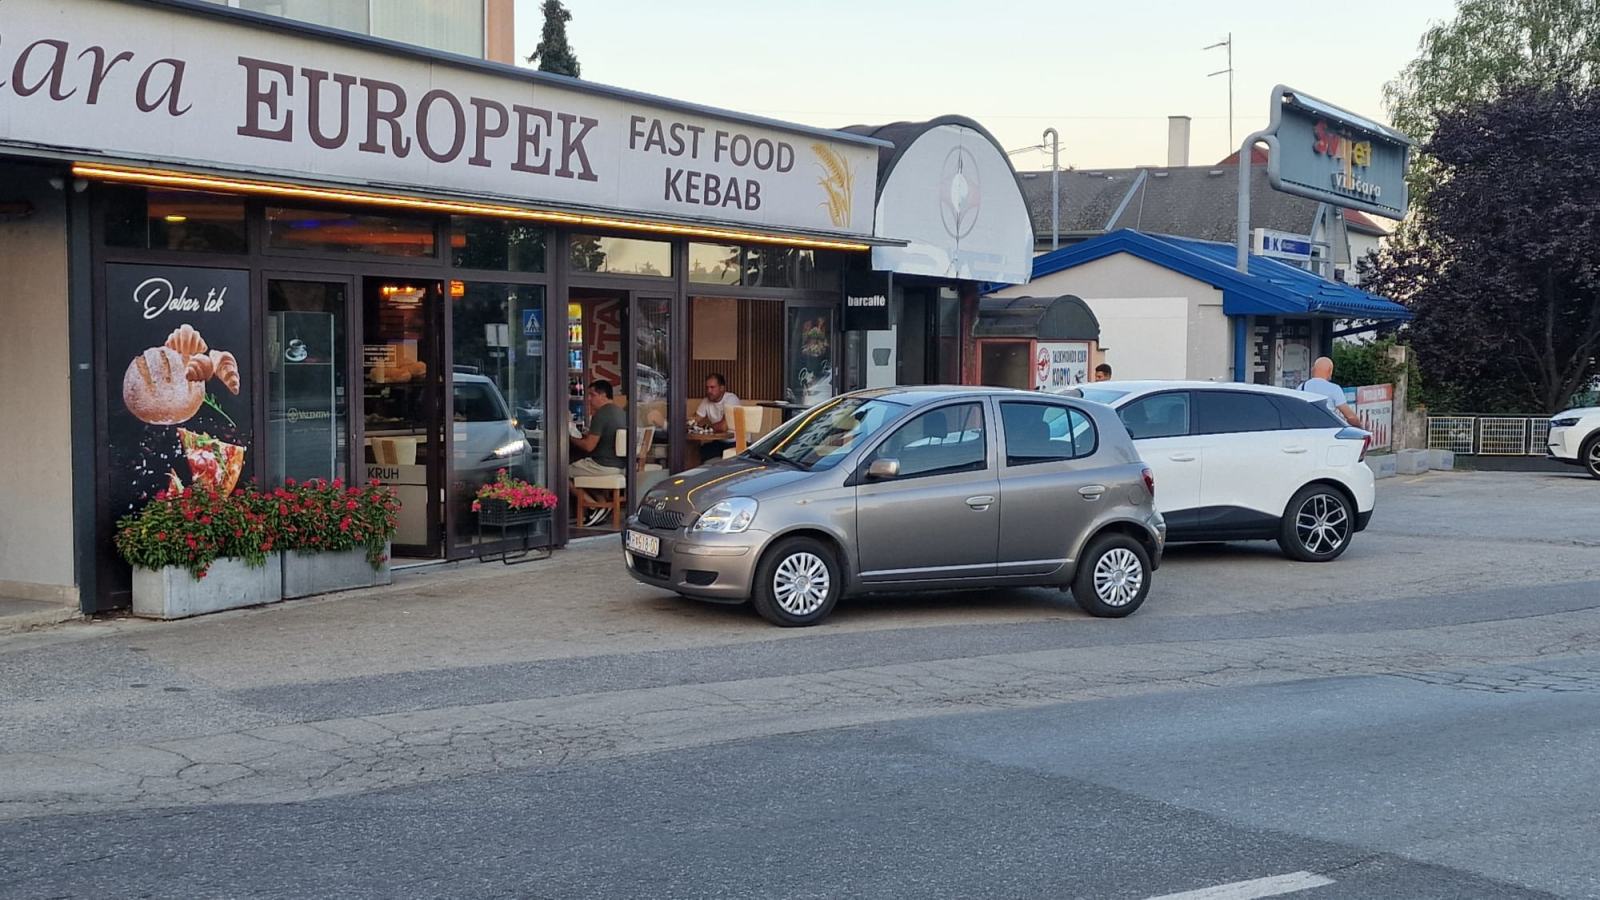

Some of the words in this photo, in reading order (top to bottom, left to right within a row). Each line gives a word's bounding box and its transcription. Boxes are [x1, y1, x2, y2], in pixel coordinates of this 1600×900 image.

[0, 39, 192, 117] ara
[237, 56, 598, 182] EUROPEK
[629, 115, 705, 159] FAST
[714, 131, 794, 172] FOOD
[664, 167, 761, 210] KEBAB
[134, 278, 200, 319] Dobar
[204, 286, 227, 312] tek
[367, 467, 399, 480] KRUH
